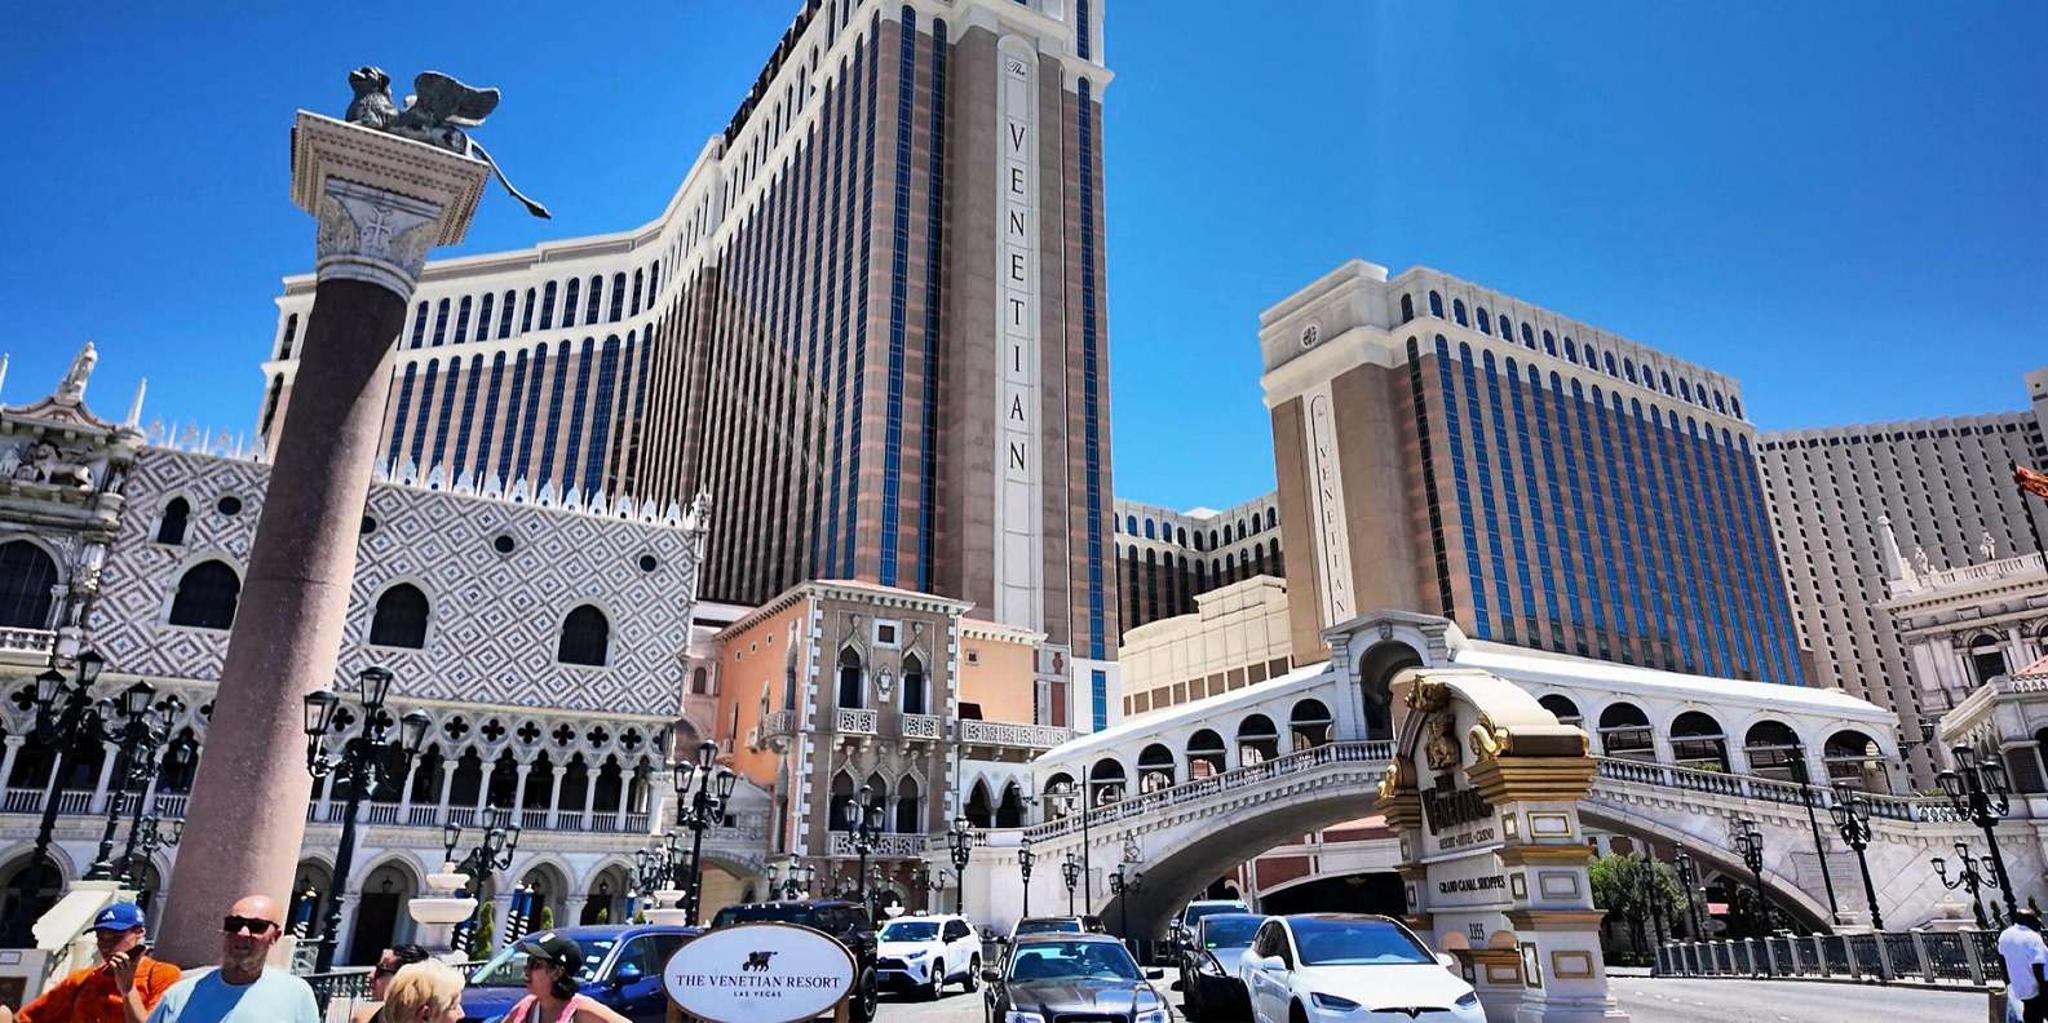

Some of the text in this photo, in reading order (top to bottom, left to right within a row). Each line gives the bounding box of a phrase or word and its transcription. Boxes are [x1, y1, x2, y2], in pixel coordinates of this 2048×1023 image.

[1006, 61, 1026, 76] The
[1009, 123, 1025, 470] VENETIAN
[676, 975, 841, 989] THE VENETIAN RESORT
